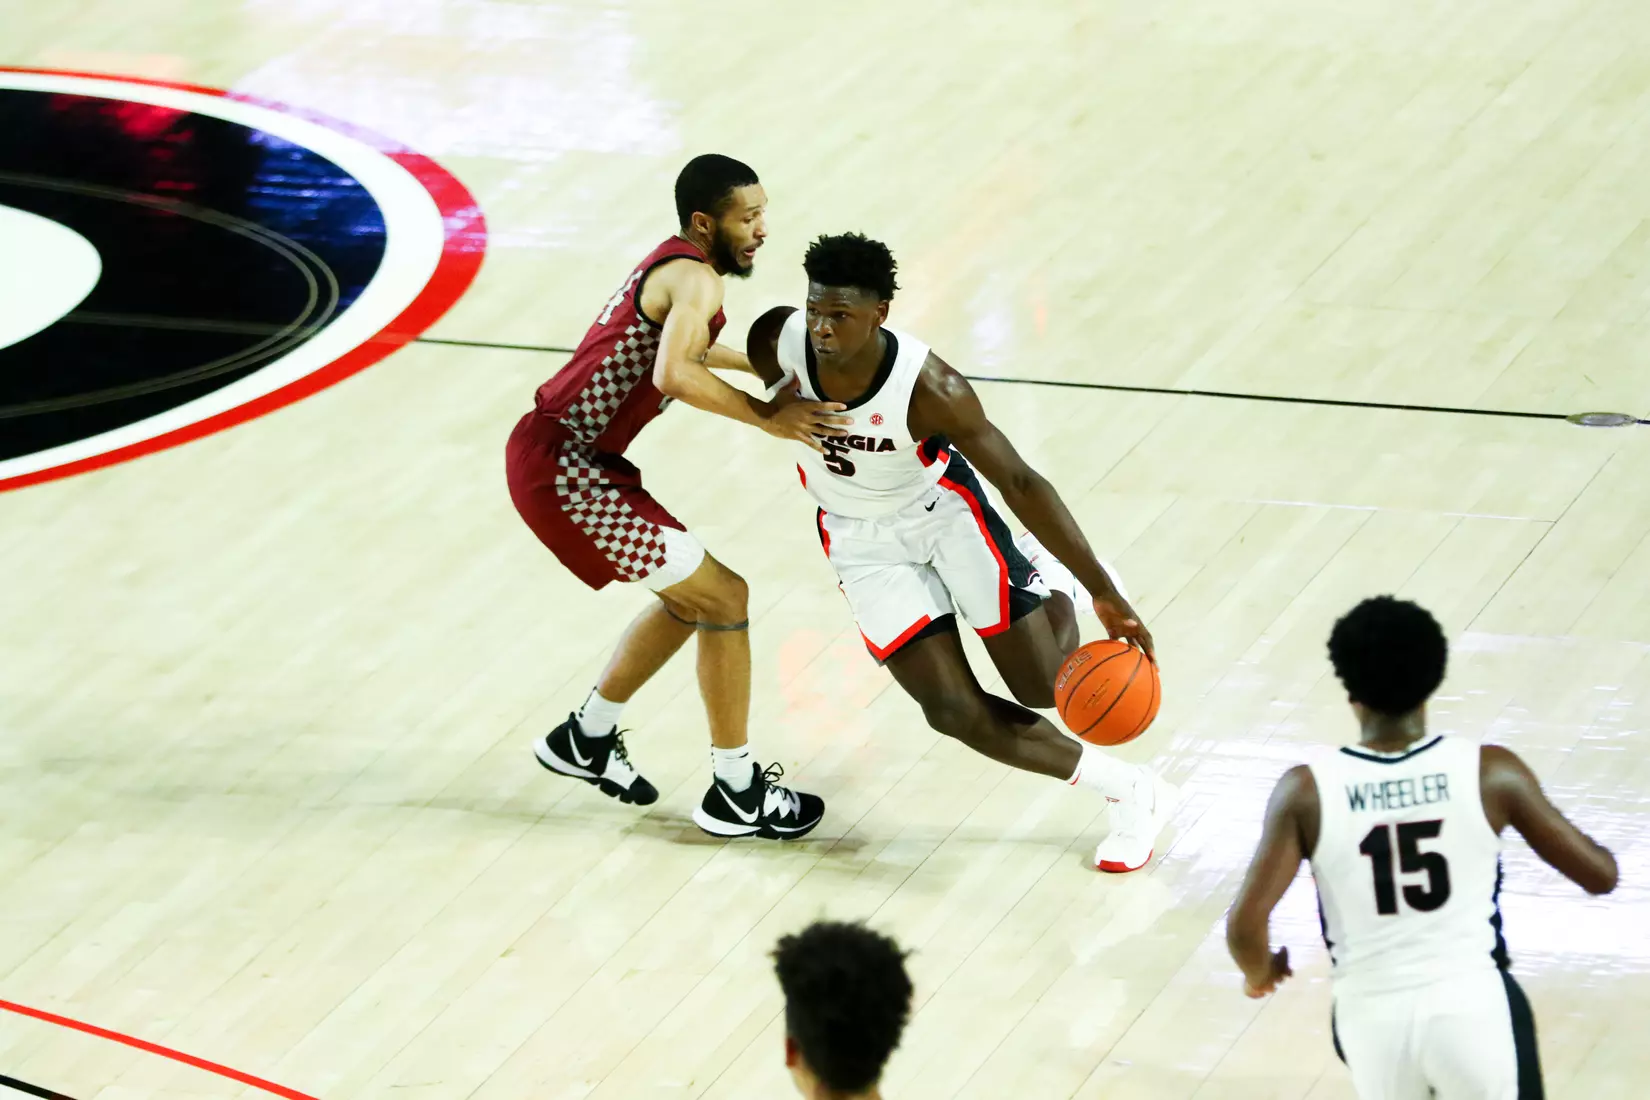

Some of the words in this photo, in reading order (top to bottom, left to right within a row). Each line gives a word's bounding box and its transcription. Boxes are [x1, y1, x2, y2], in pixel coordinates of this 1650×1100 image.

[821, 440, 856, 477] 5
[1345, 773, 1450, 812] WHEELER
[1359, 819, 1452, 915] 15
